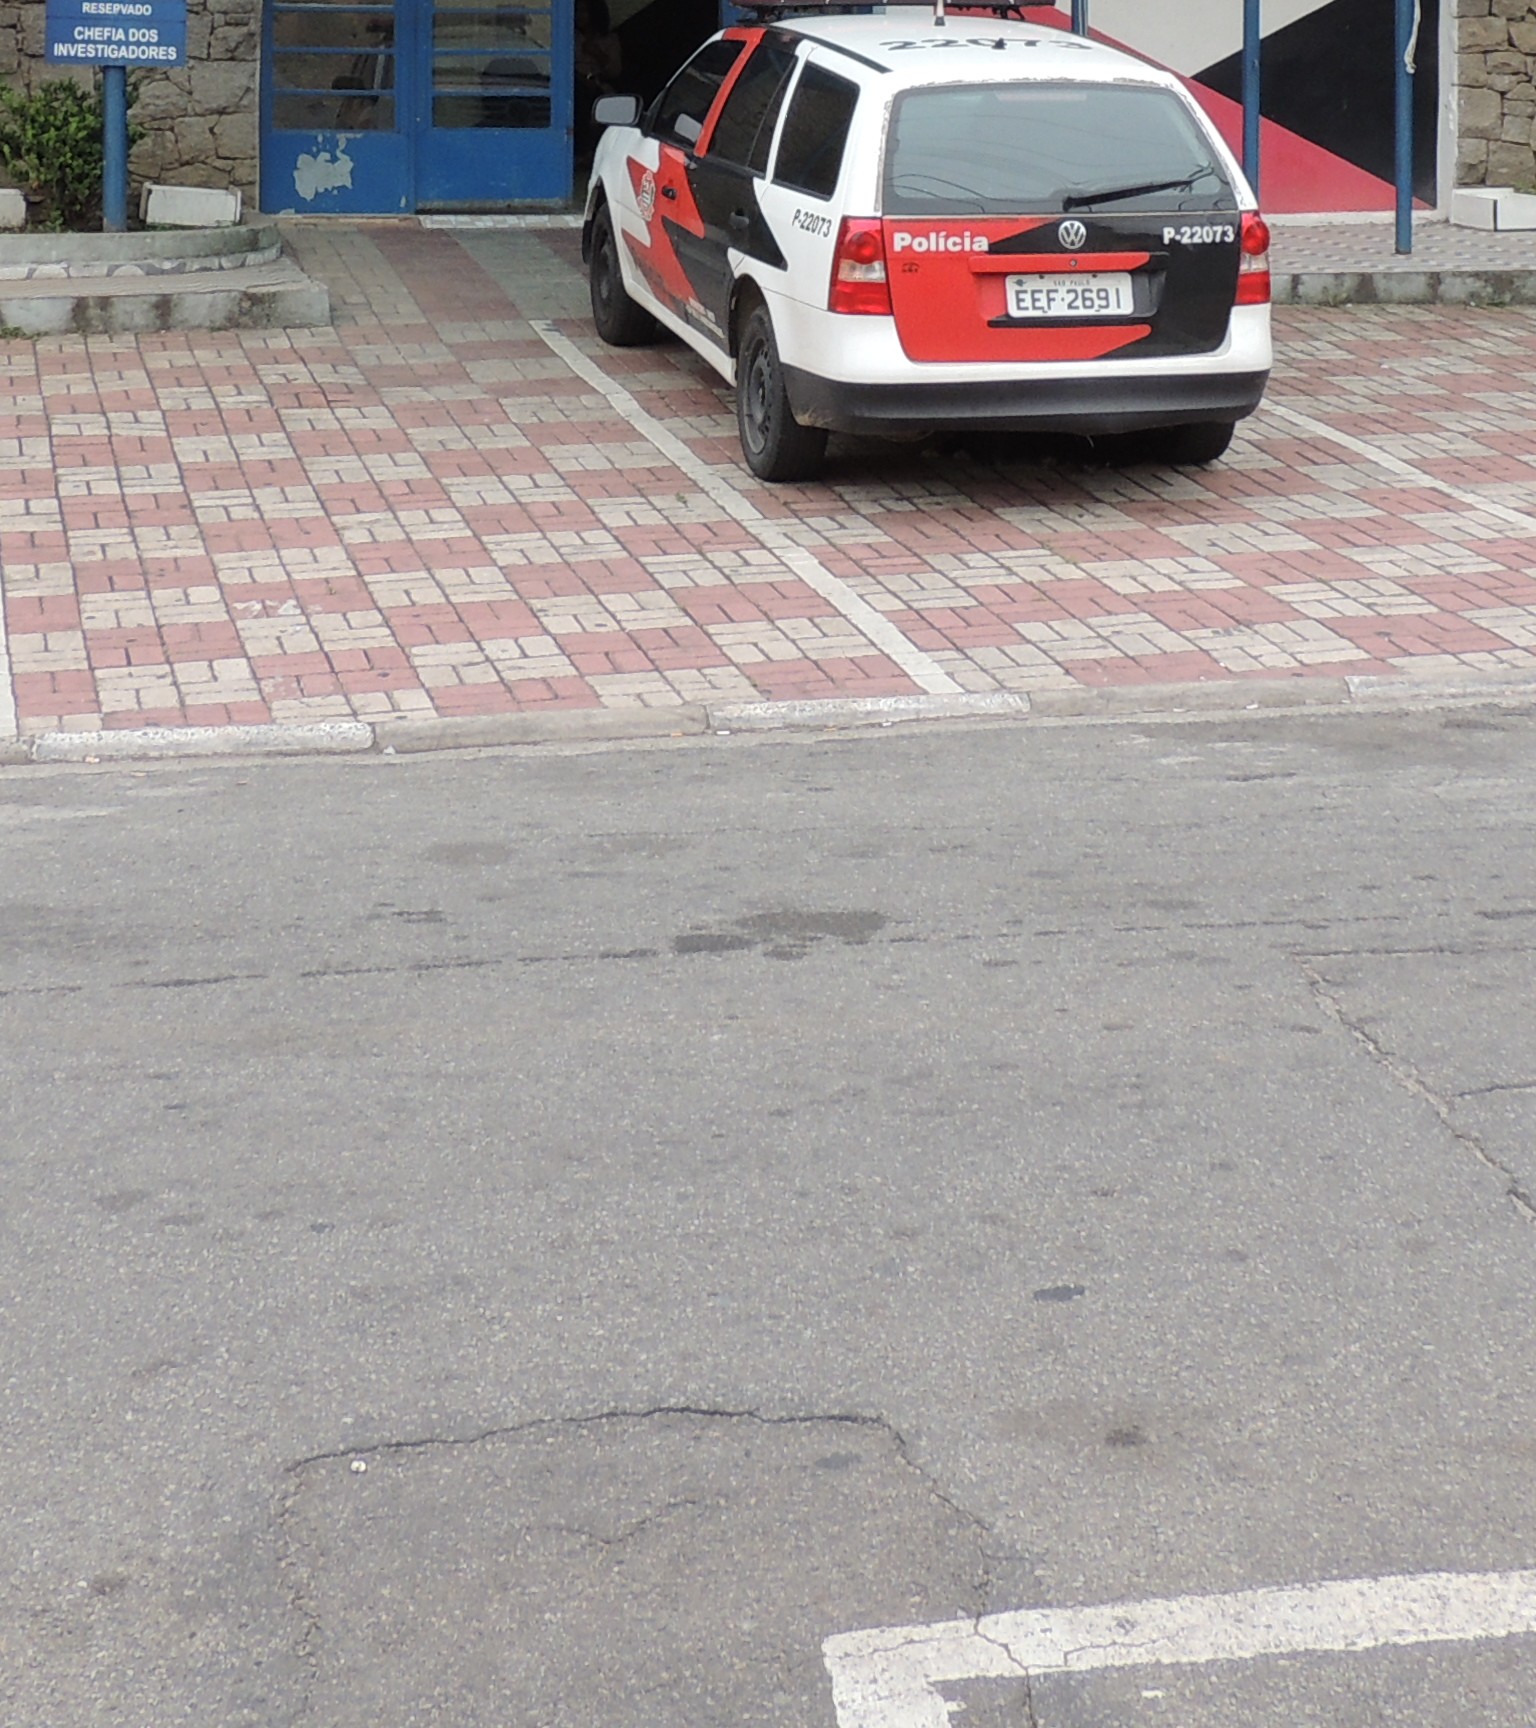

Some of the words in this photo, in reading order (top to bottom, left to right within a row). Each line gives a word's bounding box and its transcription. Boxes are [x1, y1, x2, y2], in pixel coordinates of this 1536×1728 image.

[74, 26, 126, 41] CHEFIA
[129, 29, 159, 42] DOS
[54, 43, 177, 60] INVESTIGADORES
[792, 208, 832, 238] P-22073
[893, 231, 989, 252] Polícia
[1163, 225, 1235, 246] P-22073
